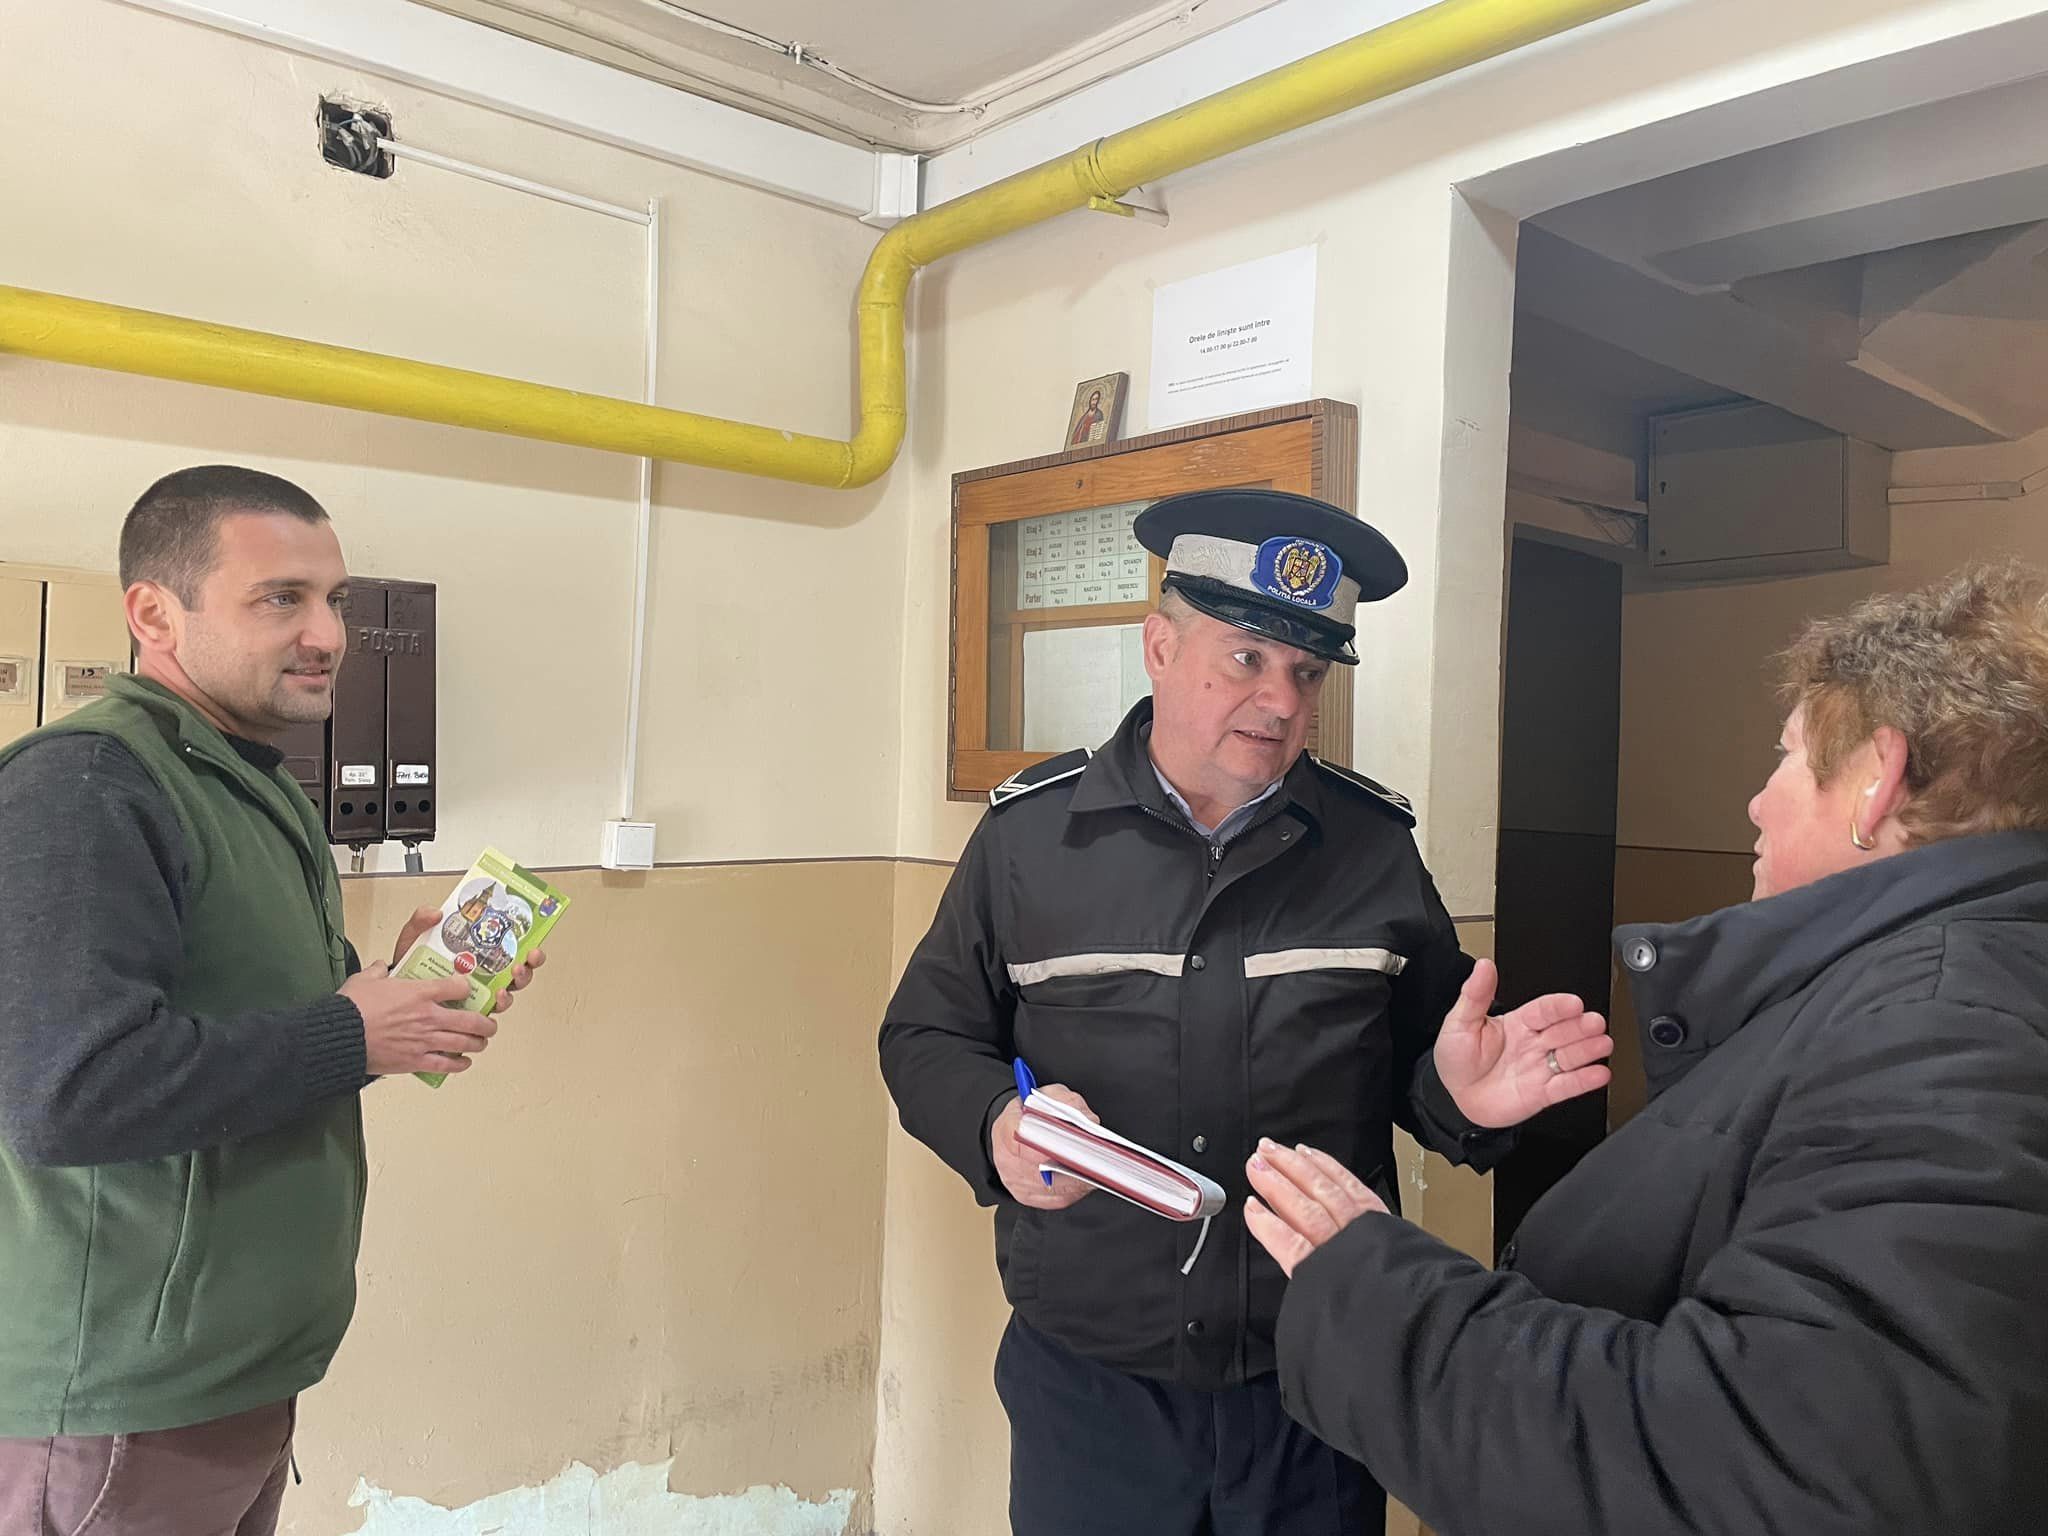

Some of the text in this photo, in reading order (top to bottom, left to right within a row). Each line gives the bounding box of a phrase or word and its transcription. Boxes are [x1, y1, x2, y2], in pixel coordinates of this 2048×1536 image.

[1189, 334, 1206, 343] Orele
[1239, 322, 1254, 332] sunt
[1026, 525, 1038, 535] Etaj
[1026, 548, 1038, 557] Etaj
[1026, 570, 1038, 580] Etaj
[1025, 593, 1041, 604] Parter
[456, 956, 474, 970] STOP
